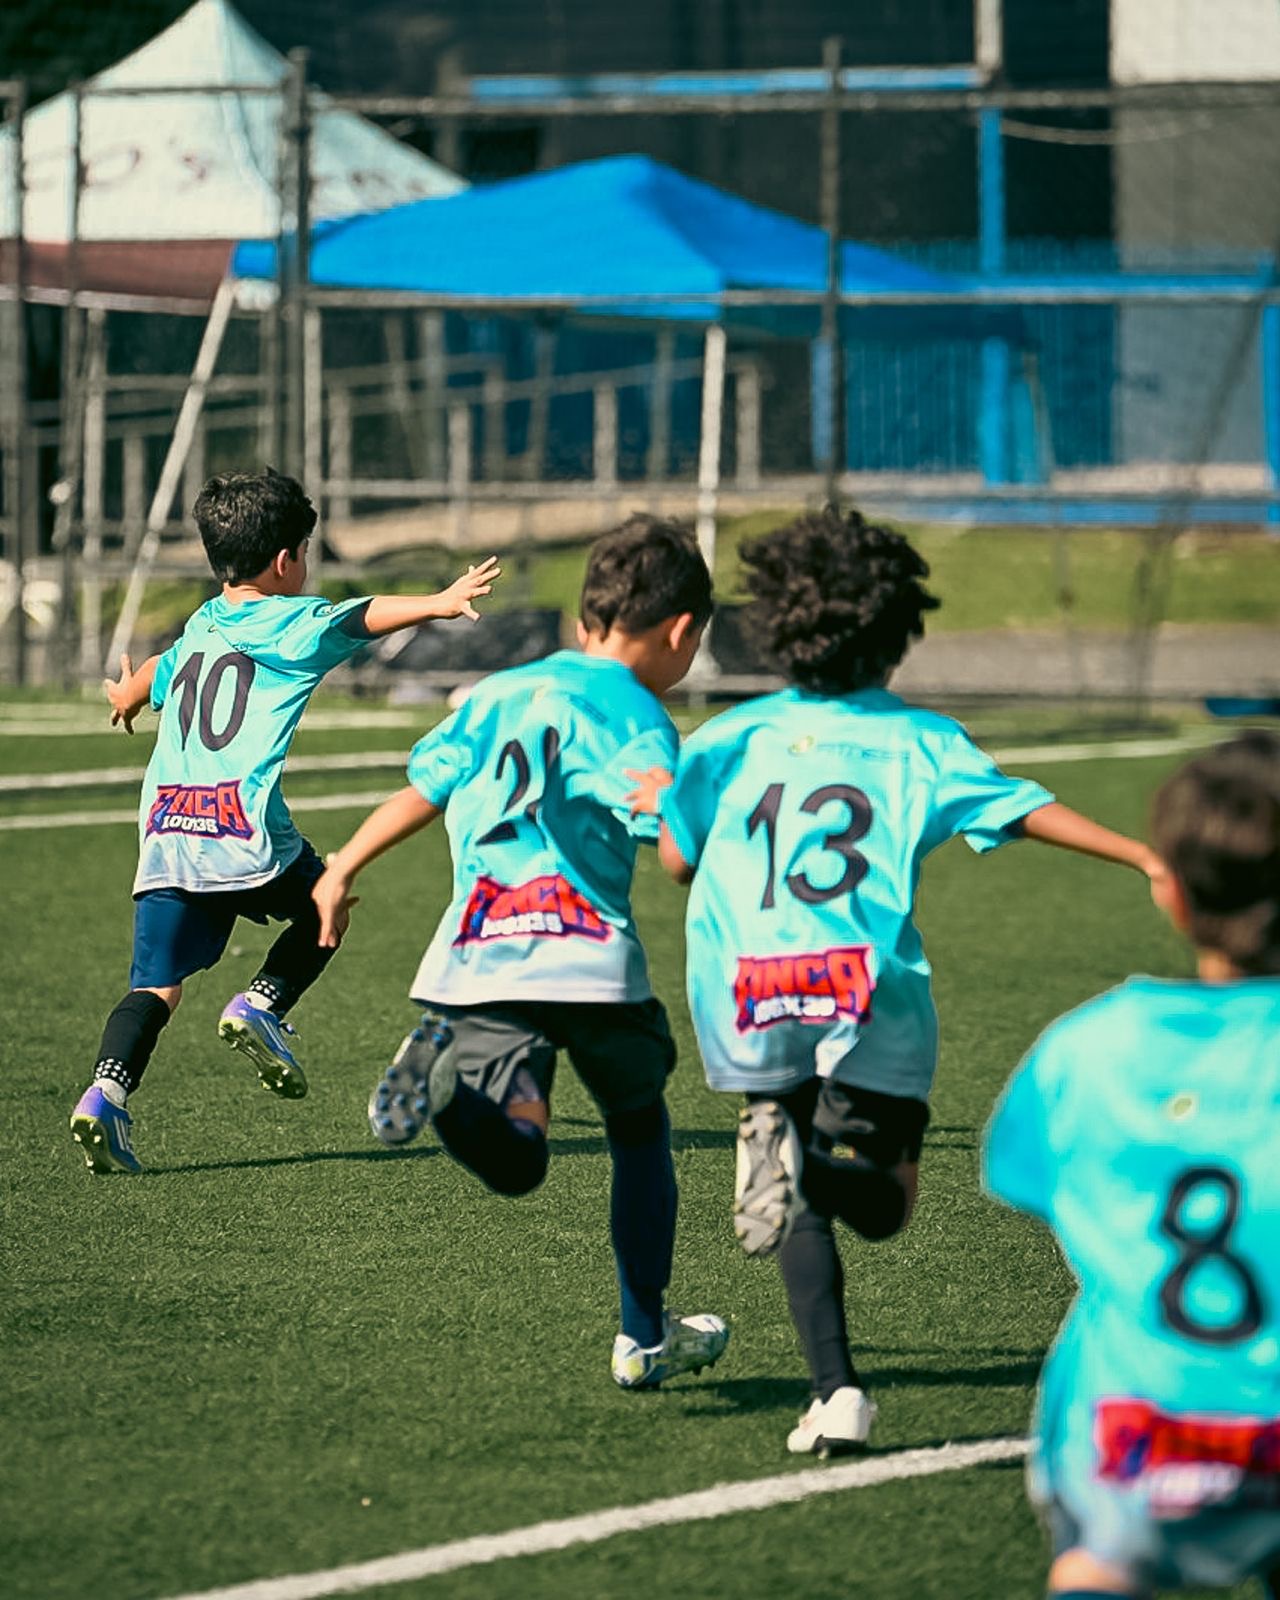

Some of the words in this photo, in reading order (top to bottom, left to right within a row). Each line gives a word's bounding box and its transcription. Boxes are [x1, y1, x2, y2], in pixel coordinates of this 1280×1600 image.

[171, 651, 255, 752] 10
[476, 726, 561, 846] 2
[746, 783, 873, 911] 13
[1161, 1167, 1264, 1344] 8
